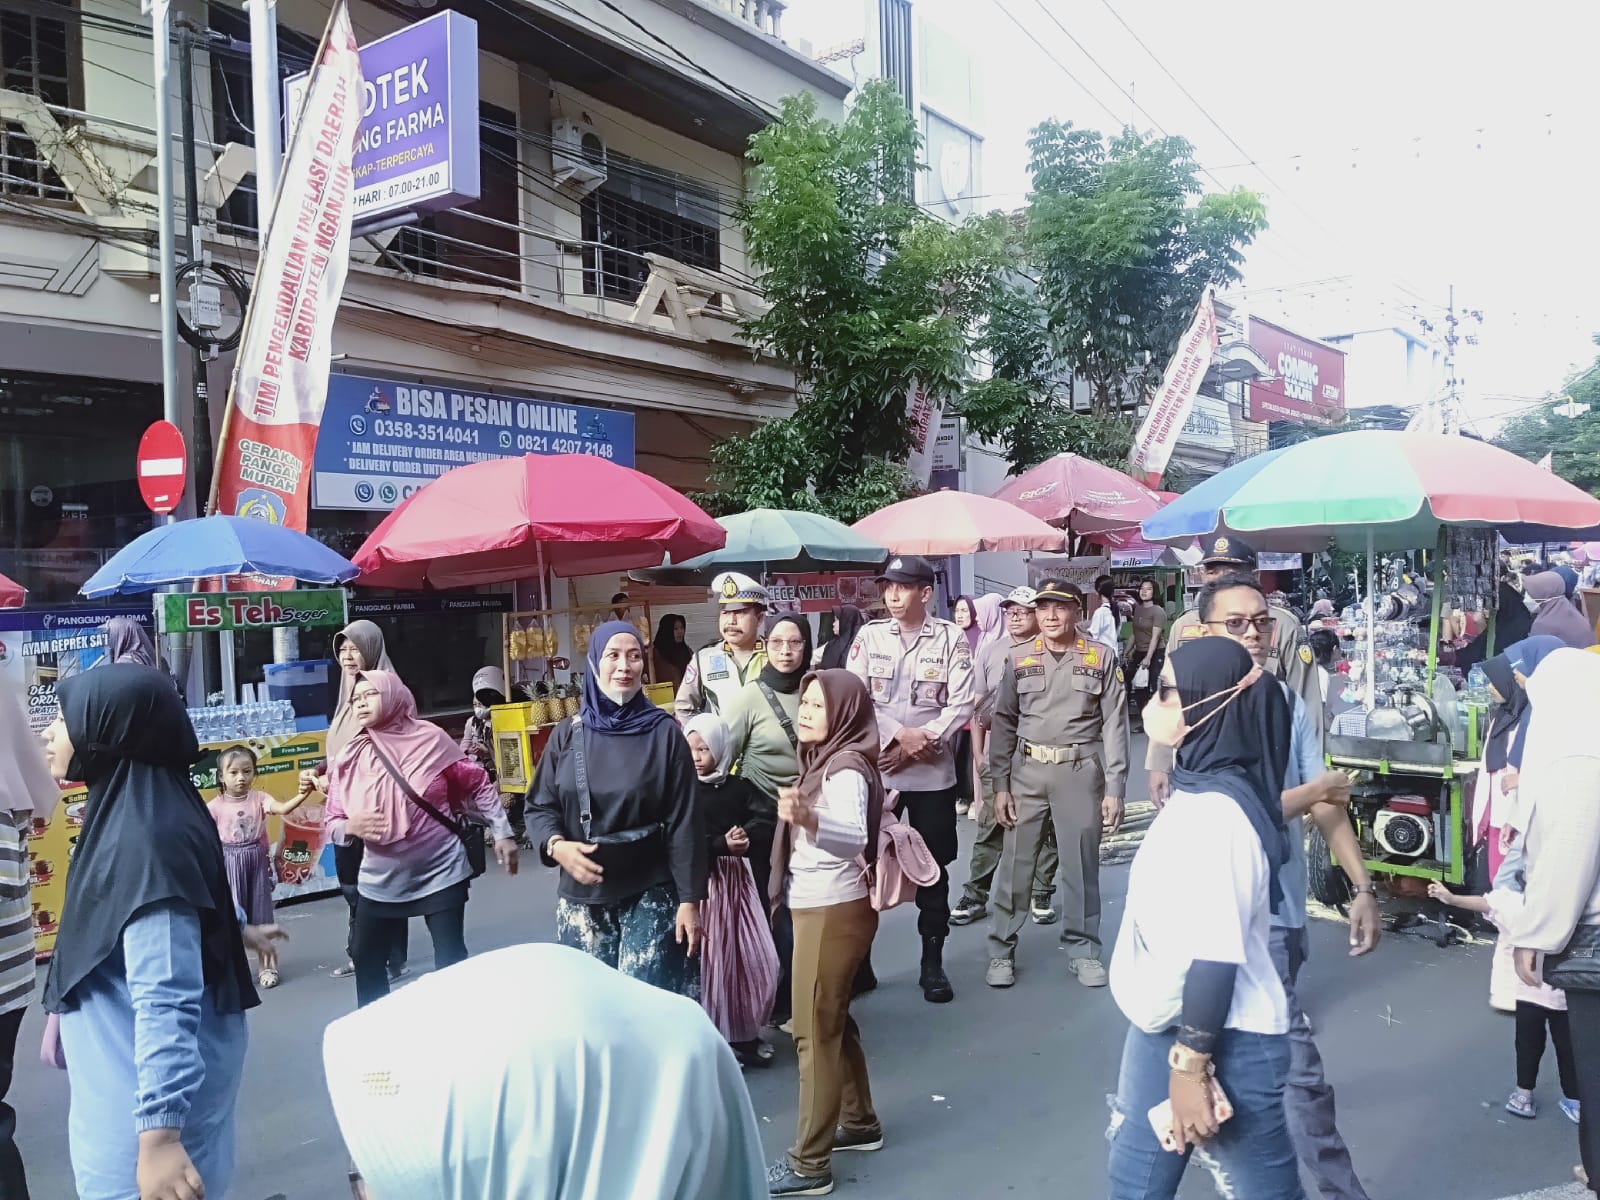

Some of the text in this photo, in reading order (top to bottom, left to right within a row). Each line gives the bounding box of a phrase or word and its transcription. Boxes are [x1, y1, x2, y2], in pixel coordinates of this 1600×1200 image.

[386, 102, 445, 144] FARMA
[358, 190, 382, 207] HARI
[388, 171, 440, 198] 07.00-21.00
[253, 76, 347, 417] TIM PENGENDALIAN INFLASI DAERAH
[288, 161, 351, 362] KABUPATEN NGANJUK
[1277, 351, 1319, 386] COMING
[1284, 376, 1313, 404] SOON
[396, 386, 578, 435] BISA PESAN ONLINE
[374, 419, 479, 445] 0358-3514041
[517, 434, 613, 459] 0821 4207 2148
[239, 438, 303, 473] GERAKAN
[349, 457, 392, 473] DELIVERY
[392, 461, 421, 474] ORDER
[351, 441, 371, 455] JAM
[372, 443, 414, 459] DELIVERY
[414, 447, 443, 460] ORDER
[444, 449, 465, 462] AREA
[240, 453, 300, 483] PANGAN
[240, 467, 297, 495] MURAH
[798, 584, 836, 600] MEME
[57, 615, 111, 626] PANGGUNG
[186, 596, 329, 628] Es Teh Seger
[22, 641, 50, 657] AYAM
[51, 636, 88, 652] GEPREK
[575, 751, 585, 789] GUESS
